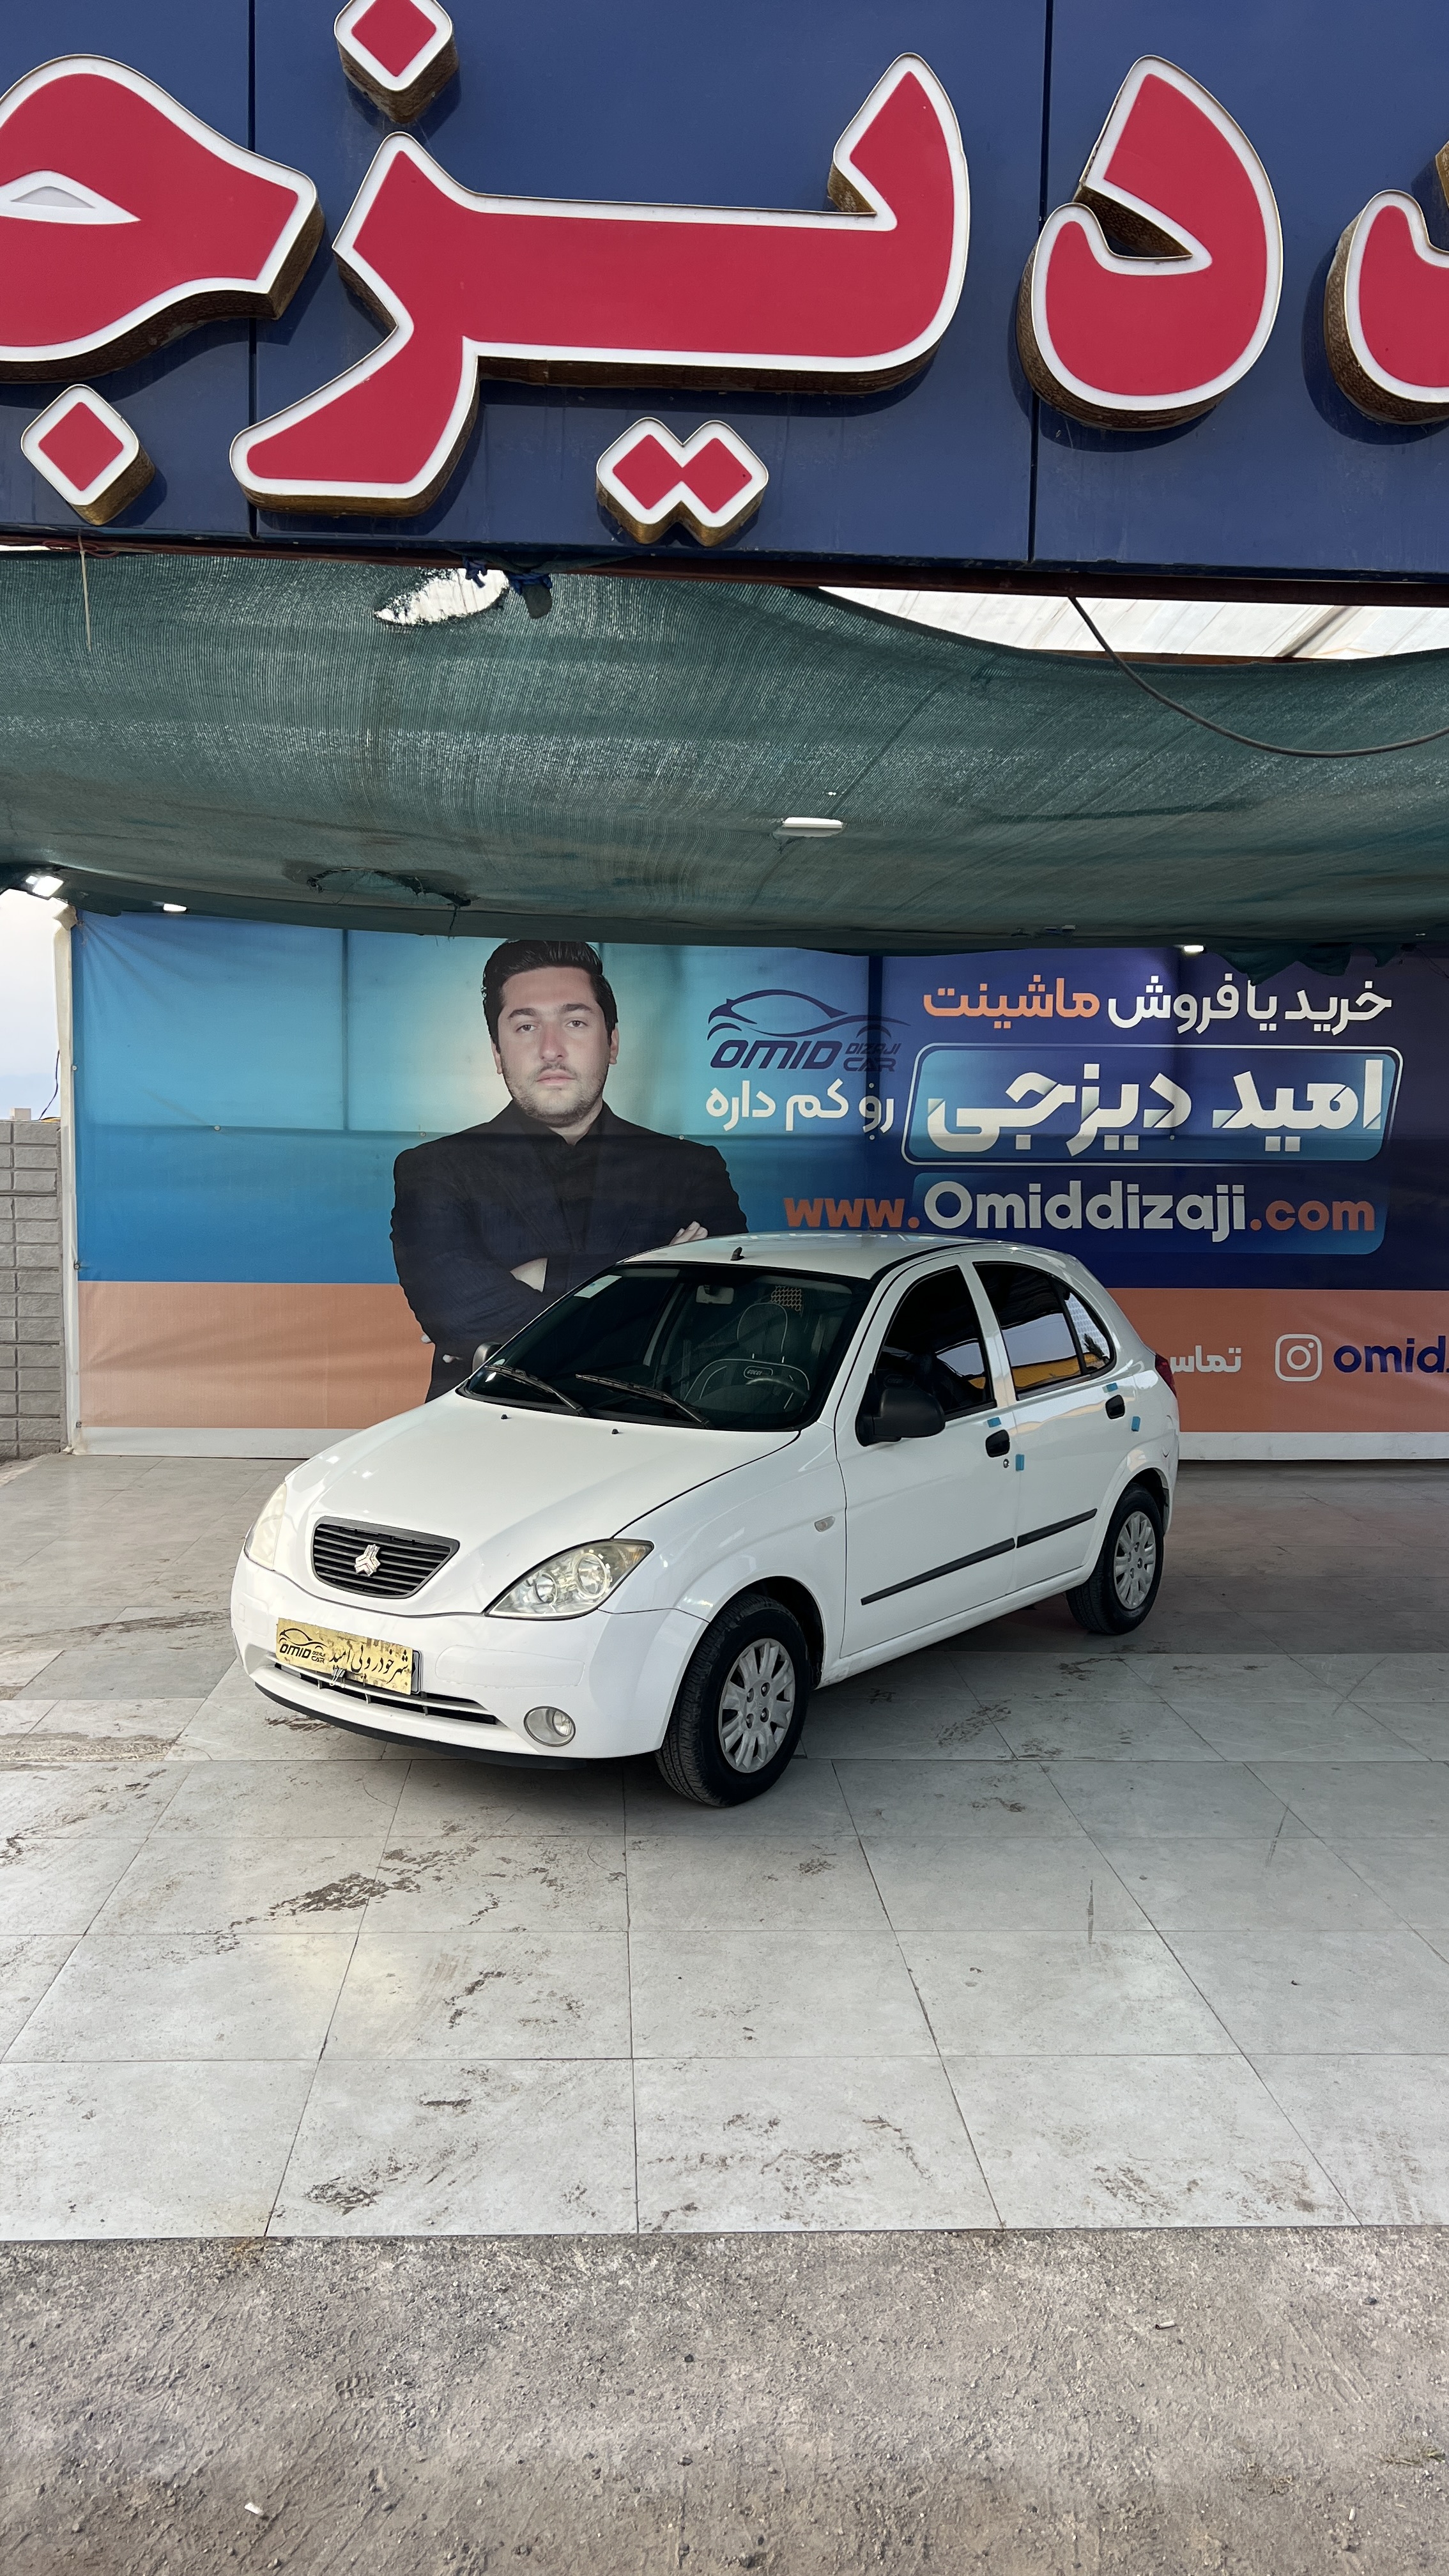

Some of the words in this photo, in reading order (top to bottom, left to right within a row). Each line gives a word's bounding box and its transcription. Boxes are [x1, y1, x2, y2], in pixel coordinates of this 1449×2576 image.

[0, 0, 1283, 544] دیزج
[923, 974, 1100, 1029] ماشینت
[1107, 972, 1239, 1034] فروش
[1246, 980, 1278, 1031] یا
[1284, 979, 1392, 1036] خرید
[710, 1039, 843, 1070] OMID
[843, 1057, 896, 1072] CAR
[845, 1043, 902, 1054] DIZAJI
[705, 1079, 776, 1132] داره
[785, 1078, 850, 1131] کم
[858, 1091, 894, 1134] رو
[927, 1062, 1193, 1157] دیزجی
[1212, 1059, 1384, 1153] امید
[783, 1179, 1376, 1243] www.Omiddizaji.com
[279, 1644, 312, 1659] OMID
[311, 1655, 325, 1664] CAR
[387, 1650, 409, 1684] شهر
